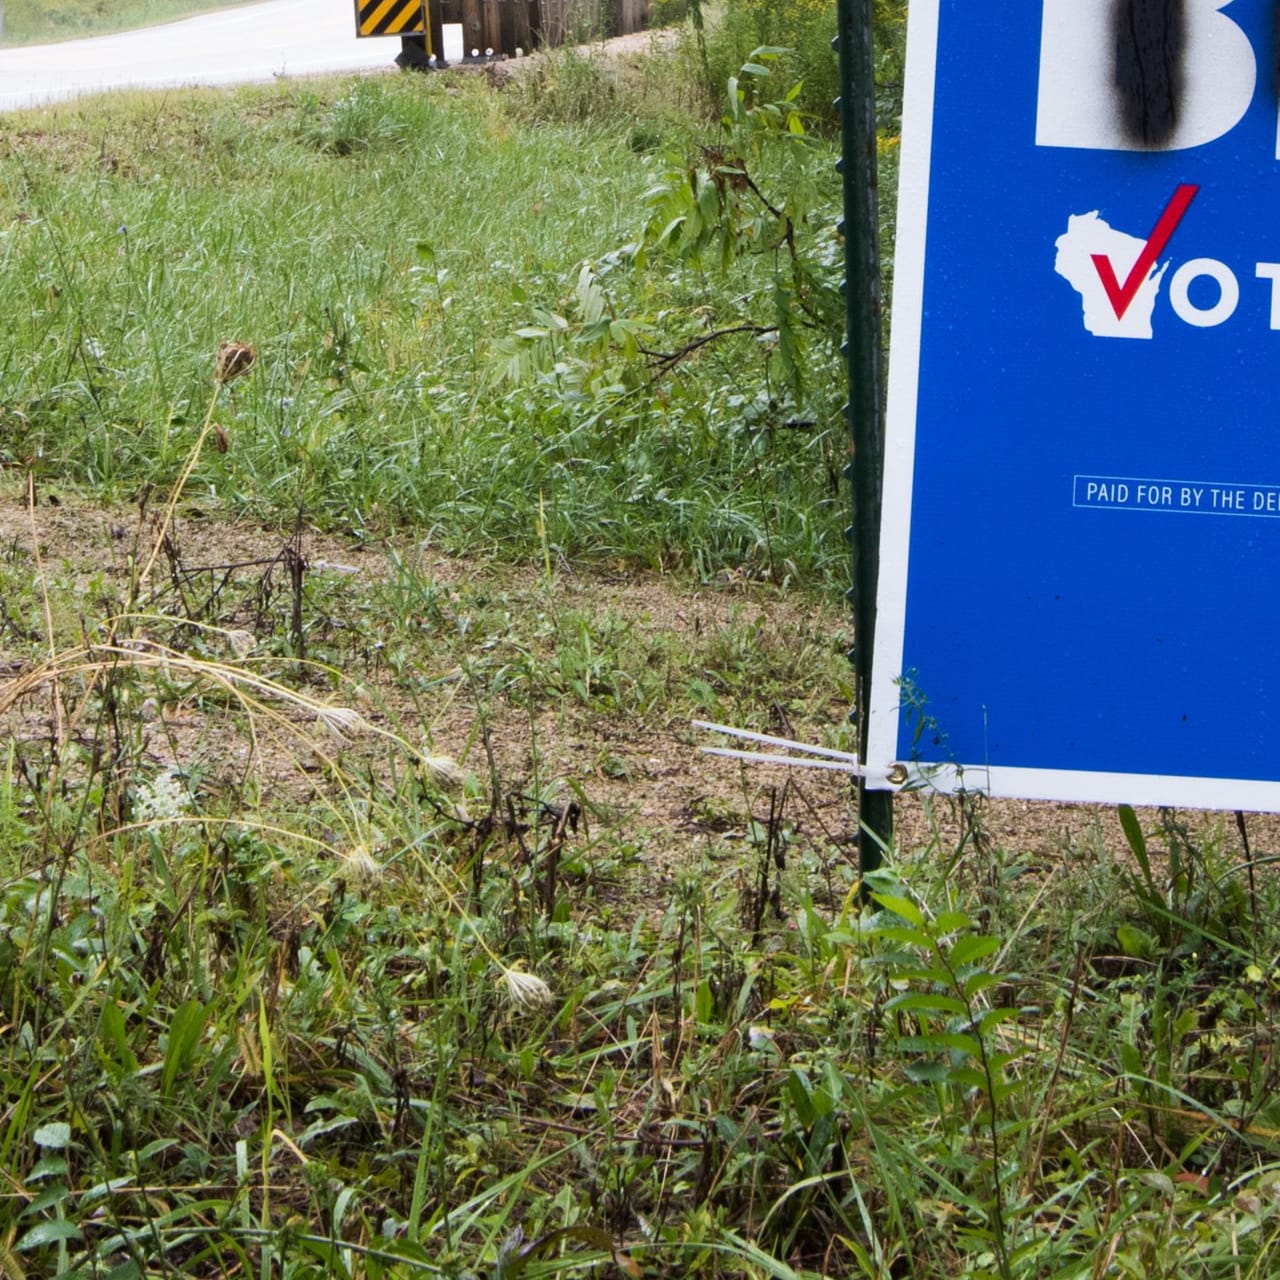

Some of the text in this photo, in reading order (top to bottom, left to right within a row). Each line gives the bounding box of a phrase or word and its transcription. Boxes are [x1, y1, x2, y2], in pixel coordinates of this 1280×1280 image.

[1086, 482, 1129, 503] PAID
[1136, 485, 1171, 505] FOR
[1180, 487, 1204, 507] BY
[1210, 489, 1245, 510] THE
